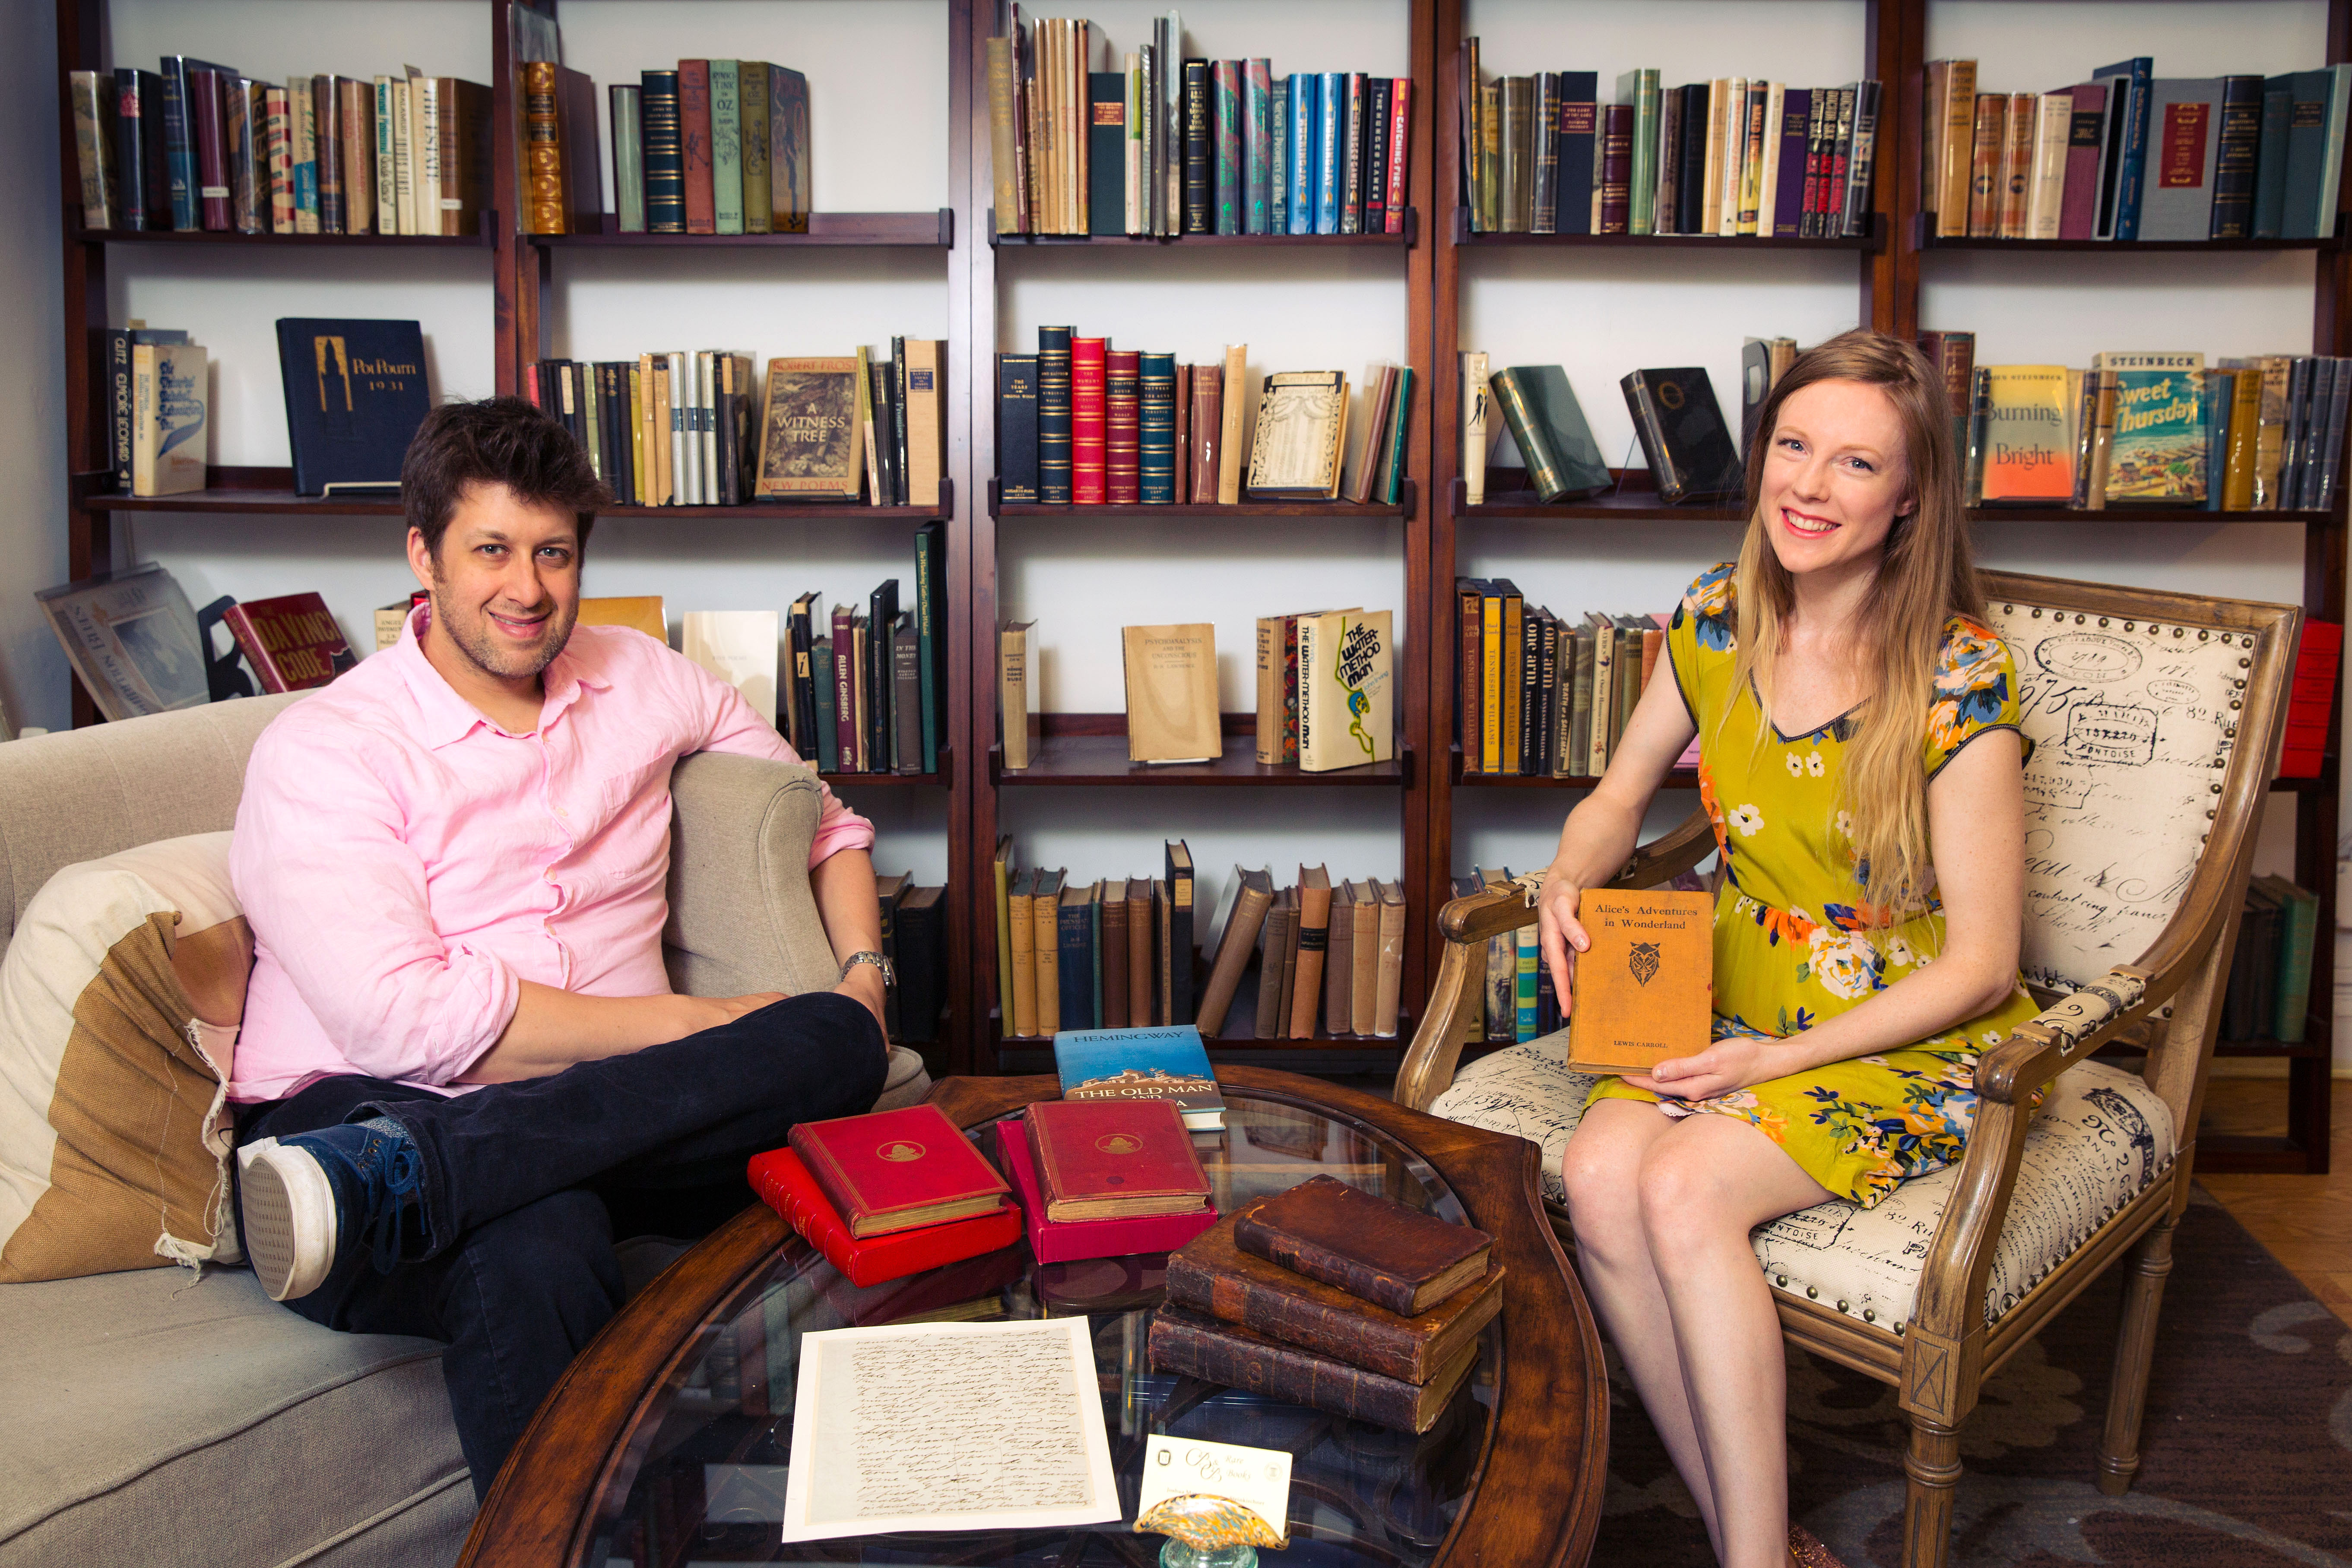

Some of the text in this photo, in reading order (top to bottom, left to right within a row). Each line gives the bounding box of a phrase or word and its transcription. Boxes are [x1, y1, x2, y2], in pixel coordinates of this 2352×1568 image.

[716, 99, 734, 111] OZ
[772, 359, 858, 371] ROBERT FROST
[2110, 356, 2196, 367] STEINBECK
[369, 380, 404, 392] 1931
[2117, 377, 2171, 406] Sweet
[806, 402, 817, 415] A
[1987, 397, 2064, 427] Burning
[2115, 397, 2200, 433] Thursday
[777, 416, 846, 429] WITNESS
[792, 430, 827, 443] TREE
[1996, 442, 2054, 471] Bright
[761, 480, 848, 491] NEW POEMS
[1144, 637, 1202, 646] PSYCHOANALYSIS
[1346, 623, 1365, 643] THE
[1341, 628, 1379, 662] WATER-
[1151, 651, 1197, 659] UNCONSCIOUS
[1339, 641, 1381, 678] METHOD
[1526, 623, 1538, 686] one arm
[1542, 627, 1555, 688] one arm
[276, 649, 330, 683] CODE
[1347, 662, 1374, 688] MAN
[837, 654, 850, 723] ALLEN GINSBERG
[1301, 644, 1309, 724] WATER-METHOD
[1508, 704, 1516, 746] WILLIAMS
[1302, 724, 1310, 749] MAN
[1560, 719, 1568, 758] SALESMAN
[1594, 904, 1698, 916] Alice's Adventures
[1604, 918, 1686, 929] in Wonderland
[1074, 1031, 1184, 1043] HEMINGWAY
[1075, 1084, 1212, 1099] THE OLD MAN
[1225, 1454, 1244, 1465] Rare
[1227, 1469, 1252, 1481] Books
